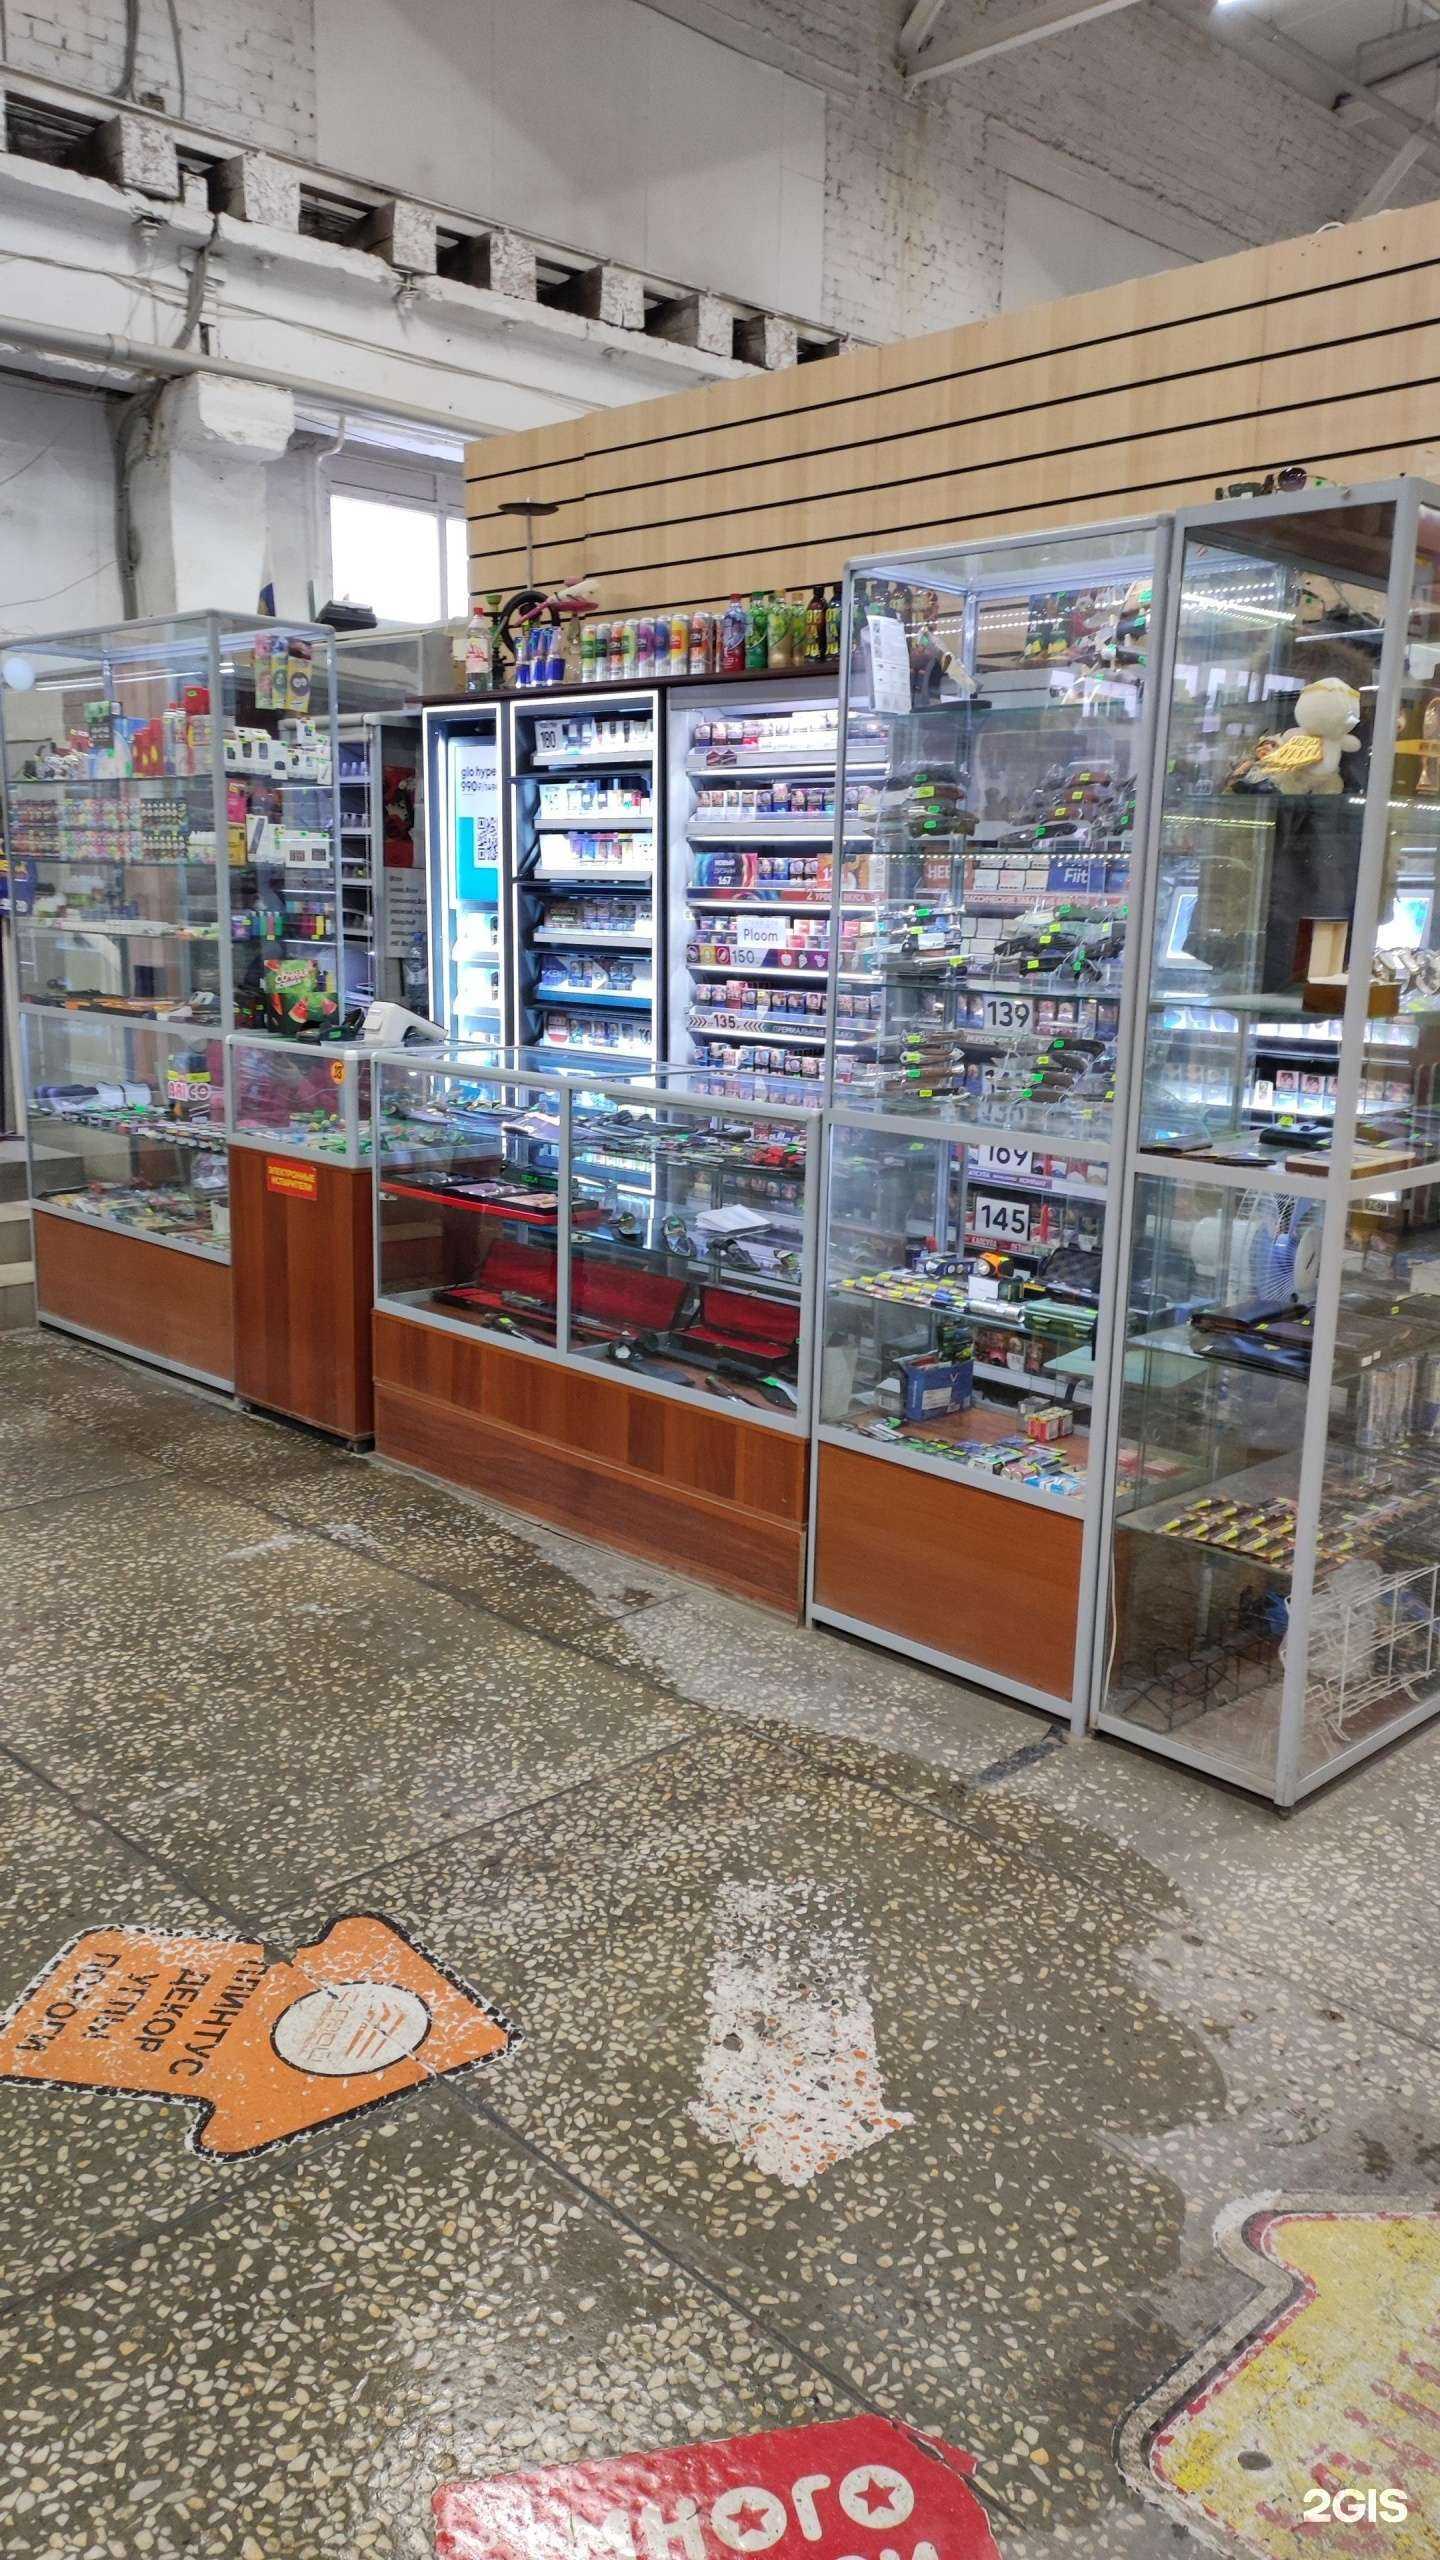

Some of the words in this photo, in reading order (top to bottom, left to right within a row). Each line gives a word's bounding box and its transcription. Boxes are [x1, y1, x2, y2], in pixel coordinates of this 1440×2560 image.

[1064, 868, 1089, 884] Fiit
[743, 928, 778, 942] Ploom
[733, 951, 755, 964] 150
[713, 1013, 736, 1029] 135
[987, 1001, 1031, 1028] 139
[981, 1205, 1025, 1233] 145
[133, 1967, 201, 2053] ДЕКОР
[170, 1960, 268, 2077] ПЛИНТУС
